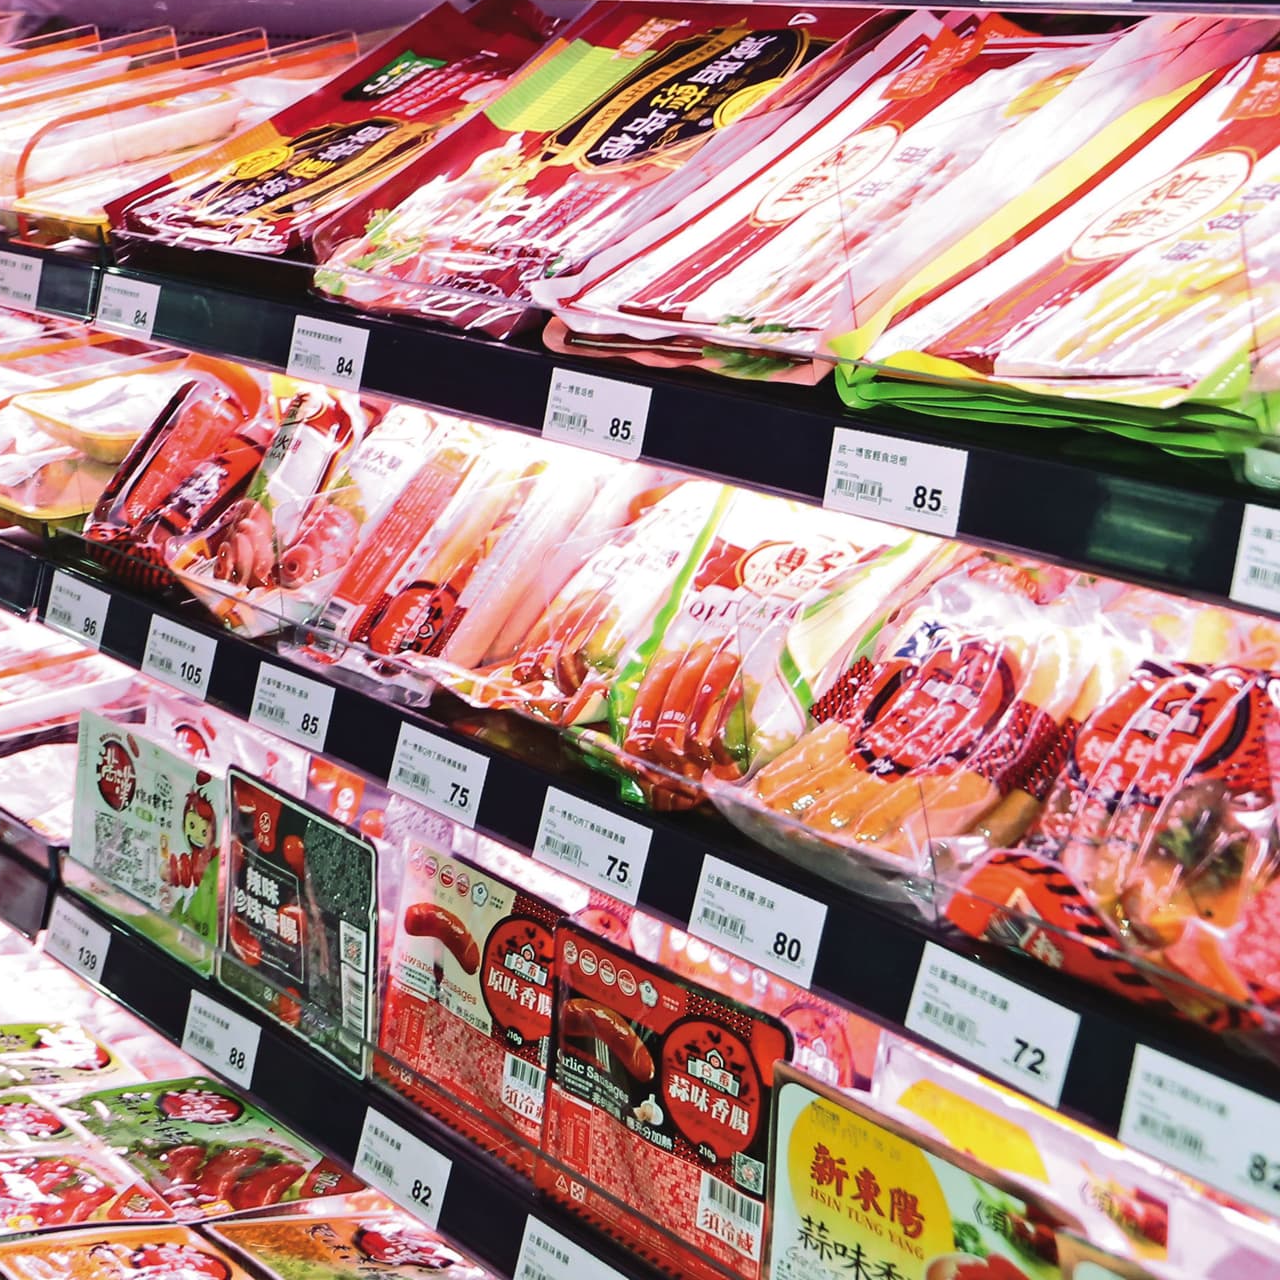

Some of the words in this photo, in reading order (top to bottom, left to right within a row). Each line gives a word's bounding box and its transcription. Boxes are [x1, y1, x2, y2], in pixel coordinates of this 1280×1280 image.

[133, 309, 148, 326] 84
[335, 355, 354, 376] 84
[608, 417, 632, 441] 85
[912, 485, 943, 513] 85
[83, 616, 97, 636] 96
[179, 661, 203, 685] 105
[300, 712, 320, 735] 85
[449, 781, 470, 809] 75
[605, 855, 631, 884] 75
[77, 944, 98, 971] 139
[772, 931, 801, 963] 80
[228, 1045, 248, 1071] 88
[1012, 1037, 1047, 1075] 72
[586, 1064, 629, 1105] Sausages
[668, 1073, 751, 1137] 蒜味香腸
[697, 1143, 718, 1164] 210g
[411, 1178, 433, 1208] 82
[810, 1141, 926, 1240] 新東陽
[810, 1185, 842, 1214] HSIN
[846, 1205, 883, 1238] TUNG
[887, 1228, 926, 1261] YANG
